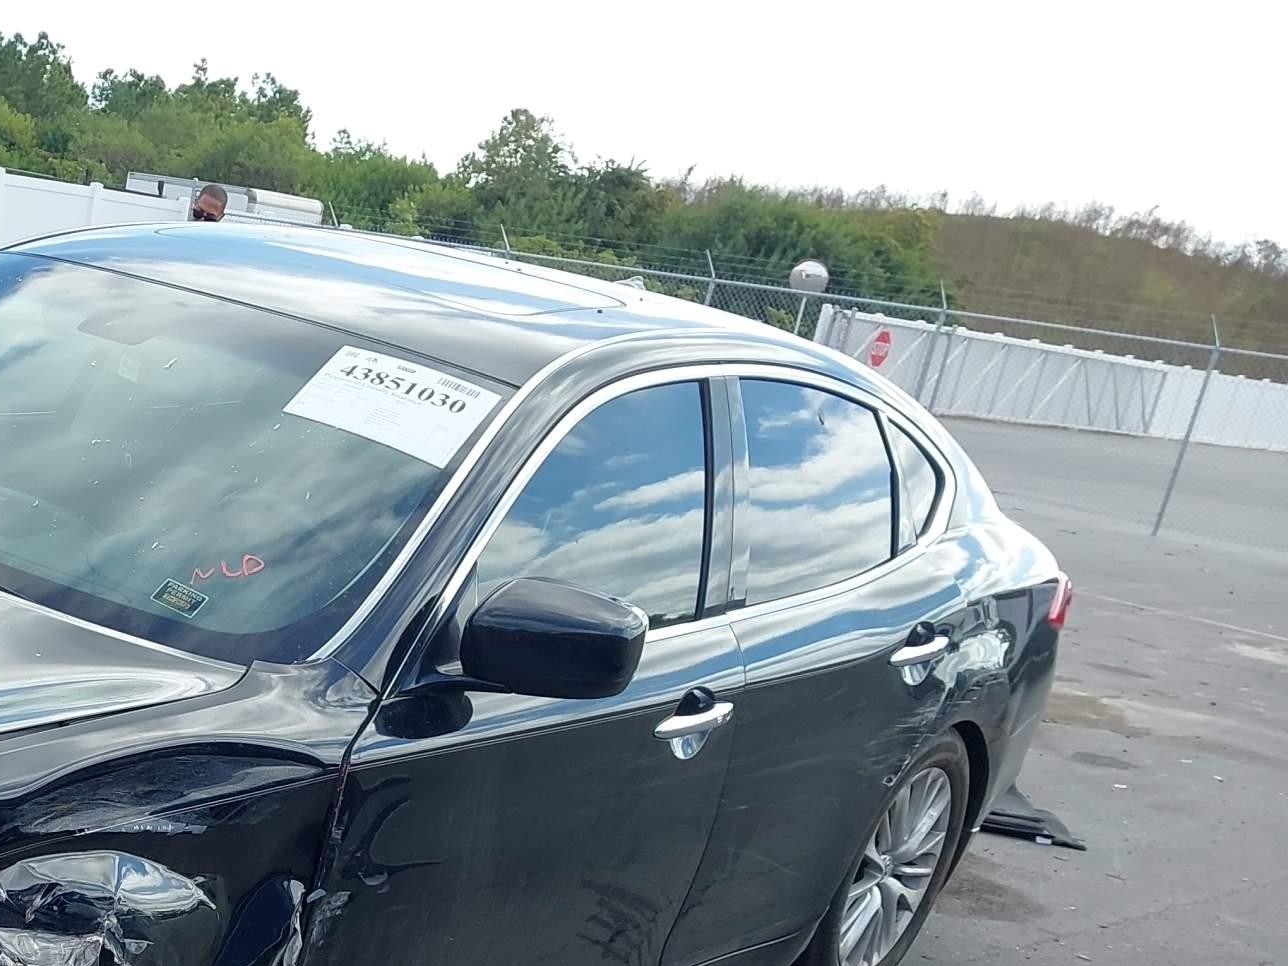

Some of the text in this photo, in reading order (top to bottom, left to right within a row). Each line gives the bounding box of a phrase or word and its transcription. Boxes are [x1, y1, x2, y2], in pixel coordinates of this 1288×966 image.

[340, 364, 467, 414] 43851030
[166, 587, 197, 605] PERMIT
[168, 582, 203, 602] PARKING
